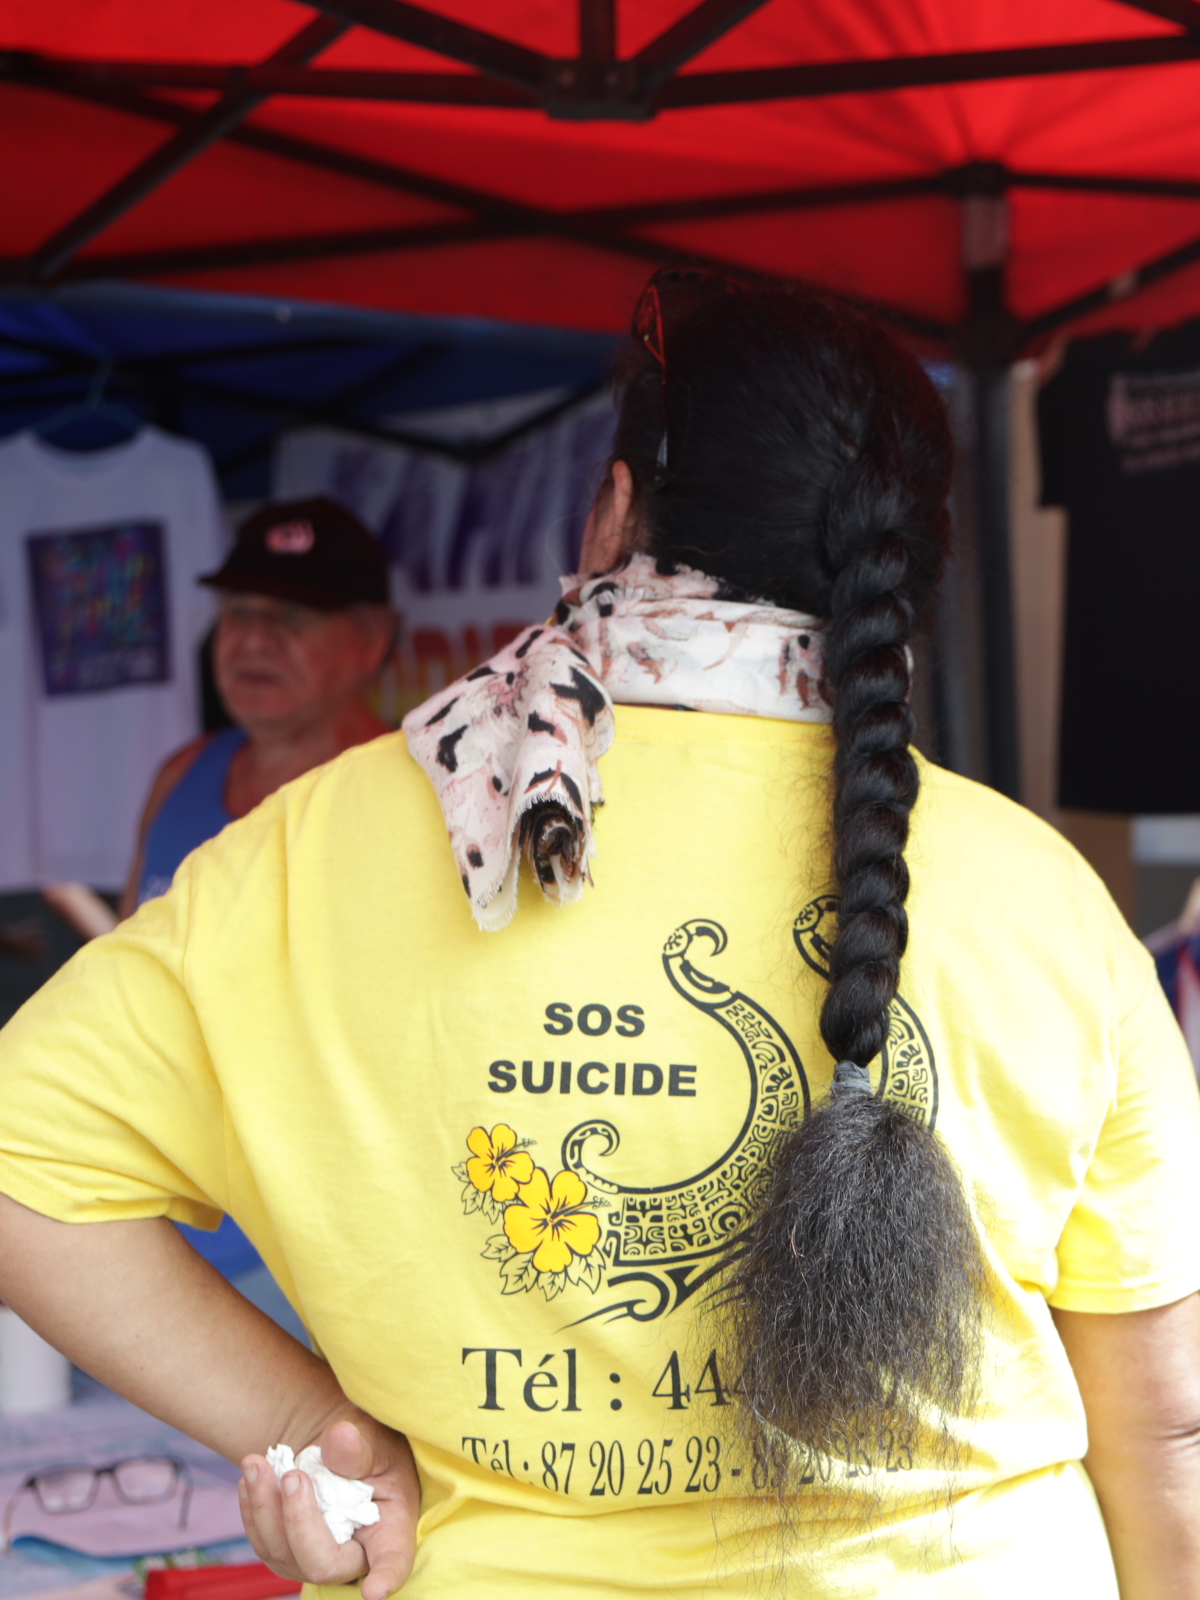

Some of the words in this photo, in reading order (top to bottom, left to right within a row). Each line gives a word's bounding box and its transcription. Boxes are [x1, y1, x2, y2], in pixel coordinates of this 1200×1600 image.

[543, 1002, 646, 1038] SOS
[487, 1060, 698, 1098] SUICIDE
[461, 1347, 582, 1412] Tél
[541, 1440, 576, 1494] 87
[589, 1440, 625, 1496] 20
[637, 1438, 673, 1494] 25
[684, 1436, 721, 1492] 23
